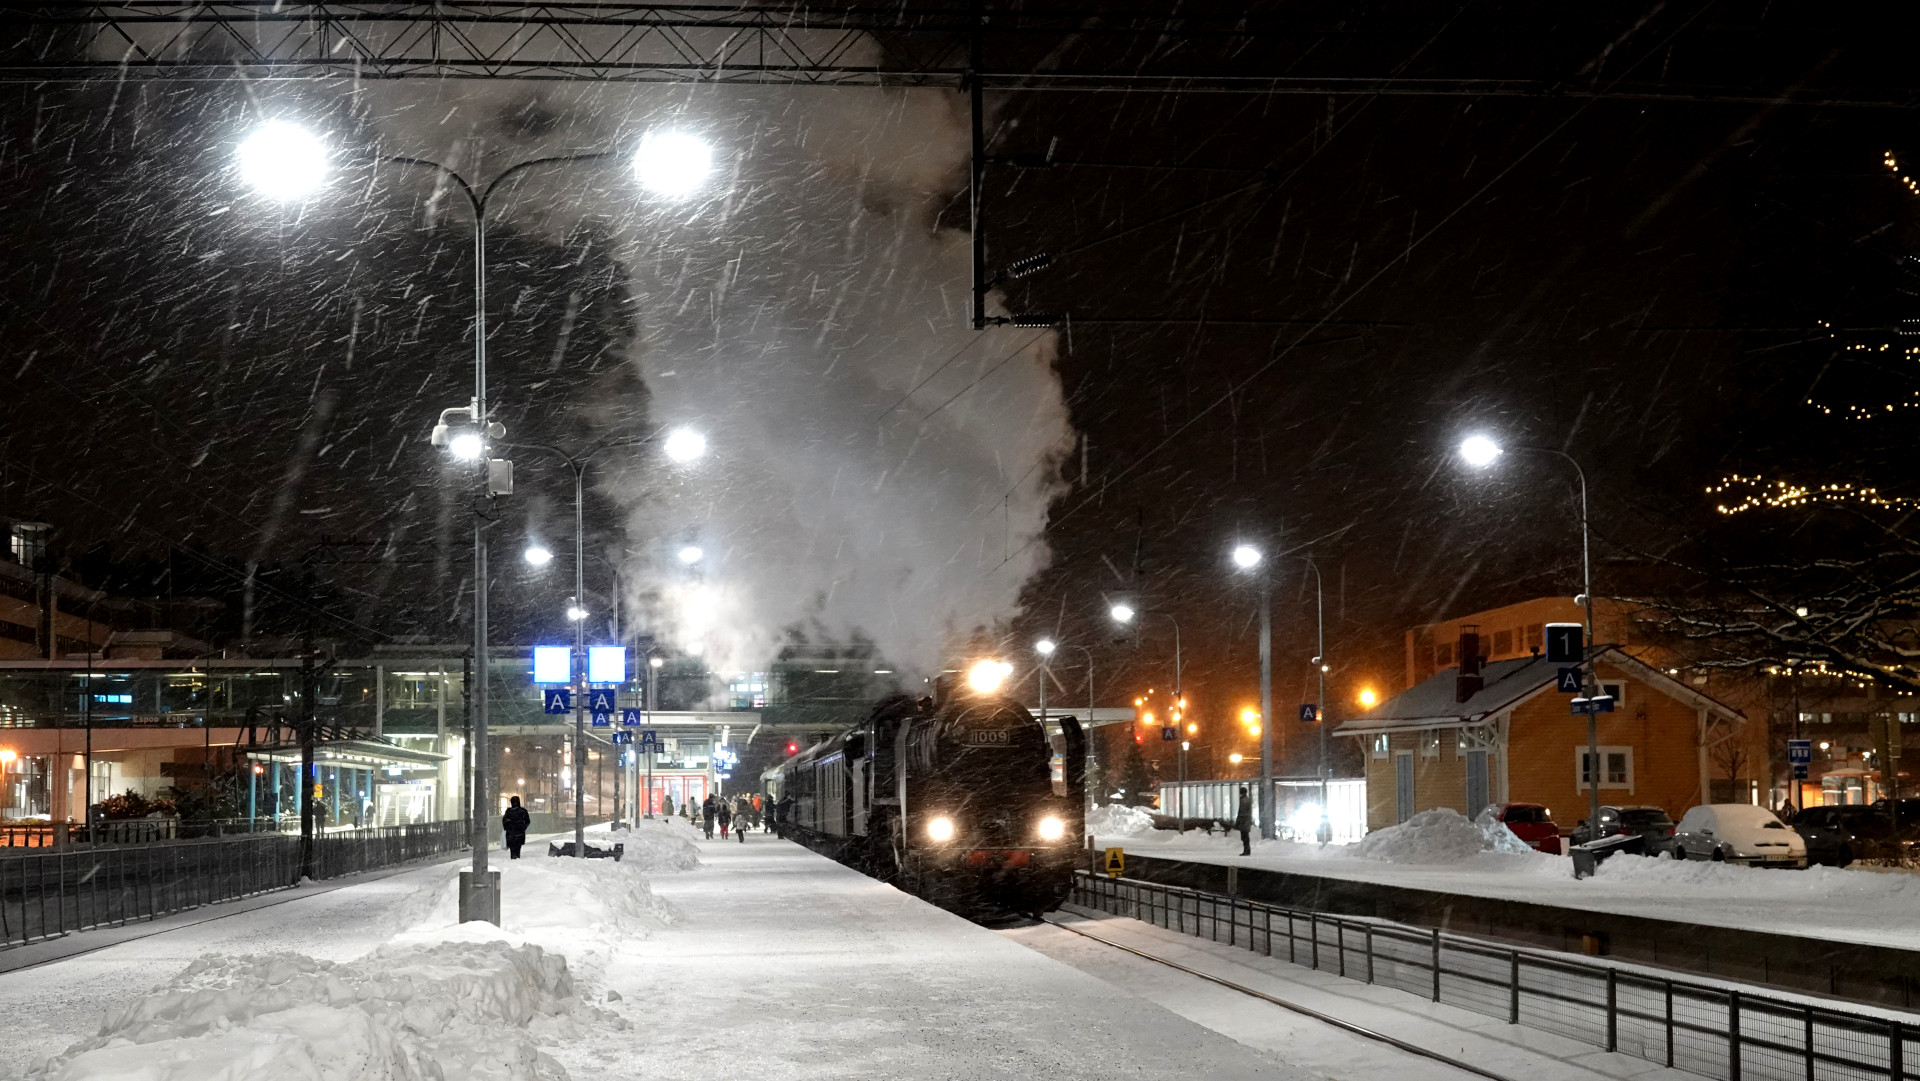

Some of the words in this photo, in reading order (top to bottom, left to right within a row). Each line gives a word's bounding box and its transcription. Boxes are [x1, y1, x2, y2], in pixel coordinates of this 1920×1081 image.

[1559, 632, 1569, 655] 1
[1563, 672, 1577, 688] A
[550, 693, 565, 709] A
[595, 693, 609, 709] A
[595, 713, 606, 723] A
[626, 712, 637, 723] A
[1303, 707, 1314, 718] A
[133, 716, 159, 724] Espoo
[622, 733, 630, 742] A
[645, 733, 654, 742] A
[974, 731, 1007, 743] 1009
[1164, 730, 1173, 739] A
